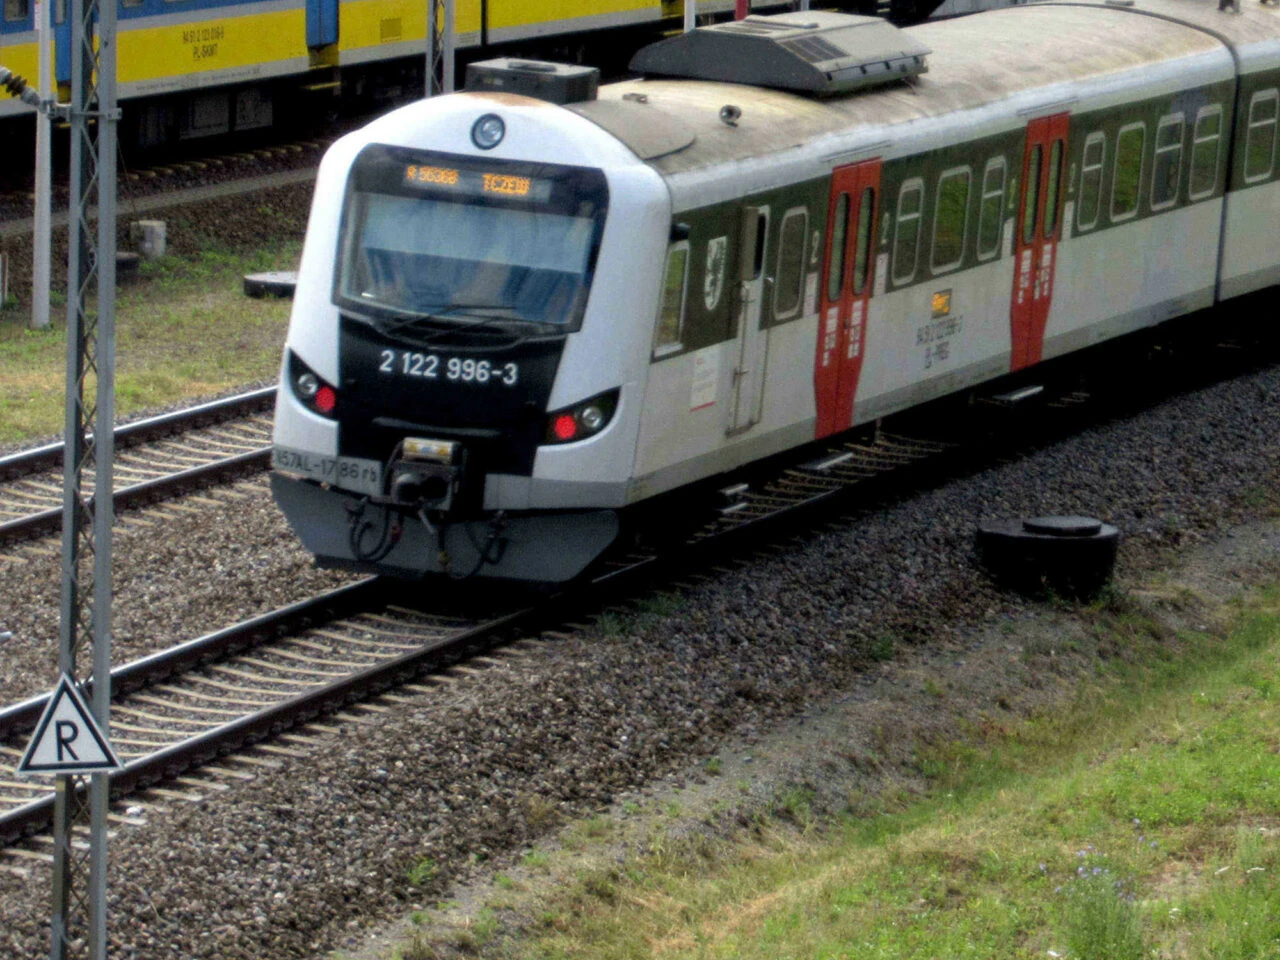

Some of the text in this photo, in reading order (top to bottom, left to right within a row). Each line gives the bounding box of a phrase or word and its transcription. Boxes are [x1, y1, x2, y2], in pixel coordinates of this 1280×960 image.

[379, 349, 518, 385] 2 122 996-3
[55, 719, 80, 761] R
